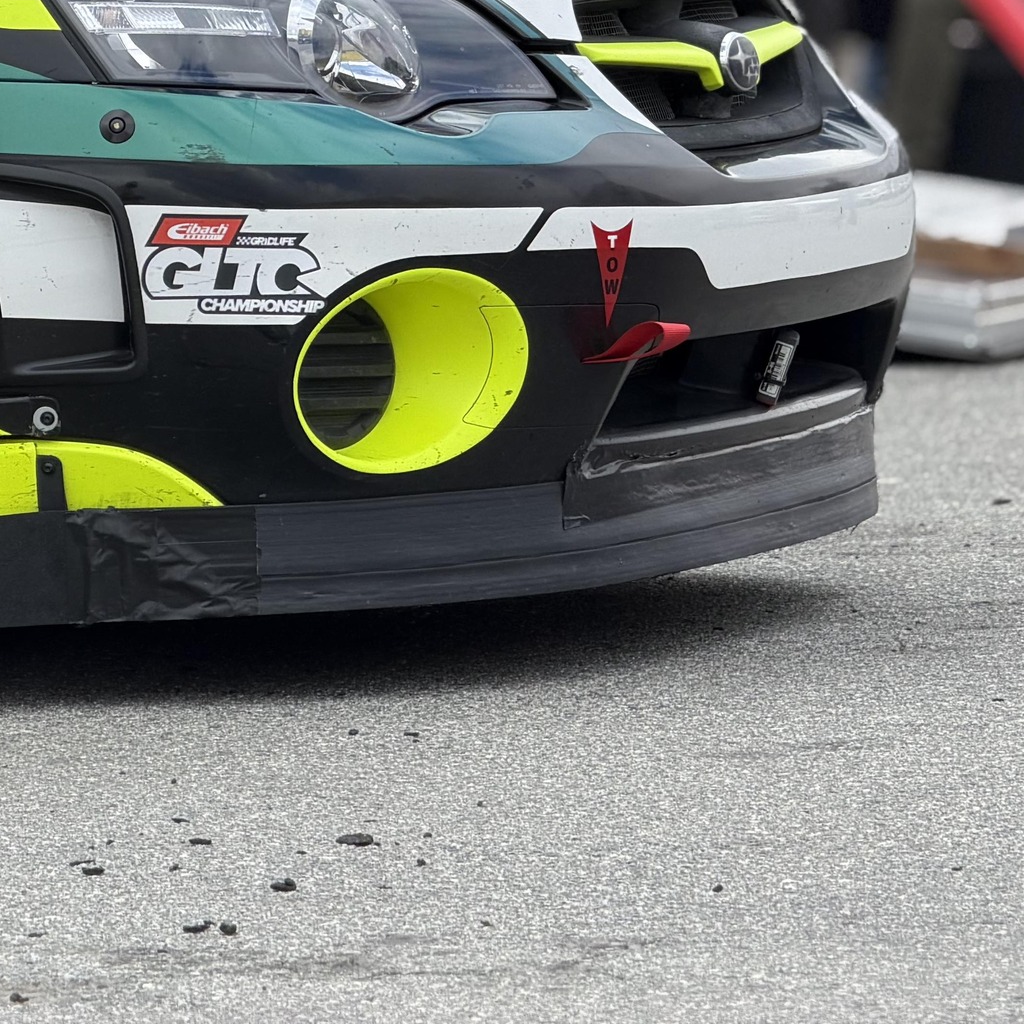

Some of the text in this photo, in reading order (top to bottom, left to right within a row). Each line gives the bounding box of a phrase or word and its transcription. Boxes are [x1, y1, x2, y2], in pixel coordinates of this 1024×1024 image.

[166, 222, 230, 241] Eibach
[143, 246, 322, 298] GLTC
[199, 297, 326, 315] CHAMPIONSHIP
